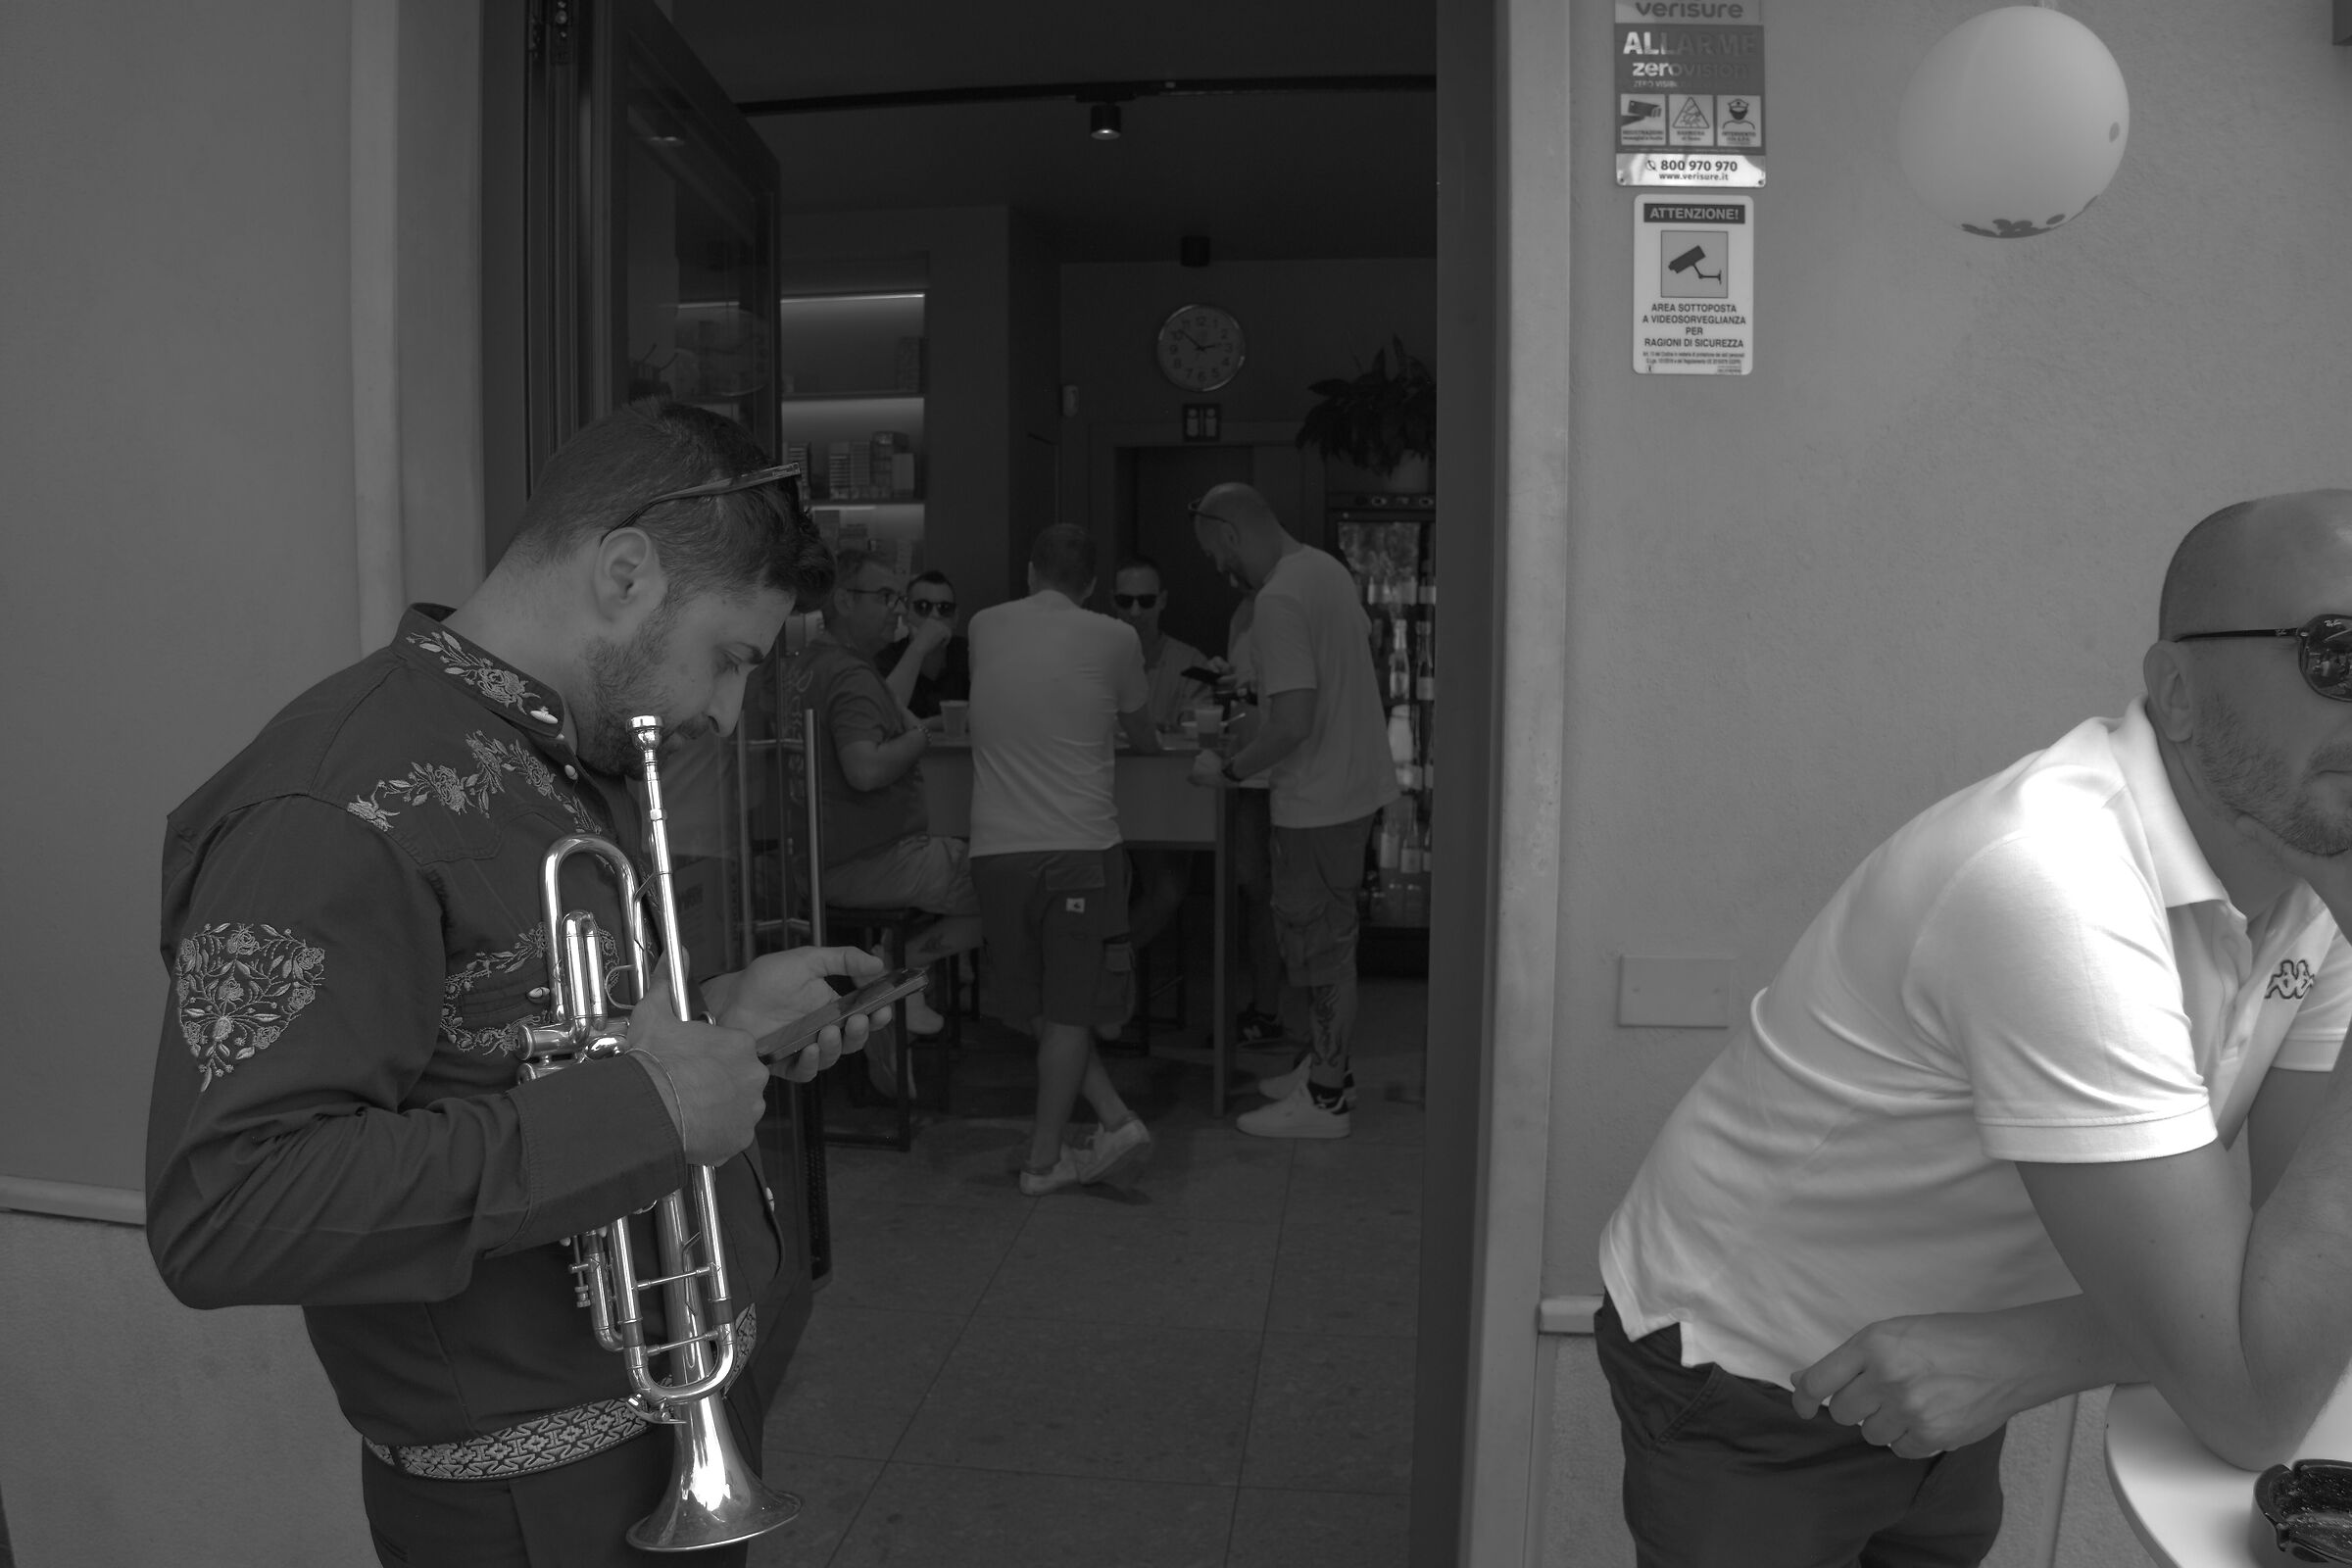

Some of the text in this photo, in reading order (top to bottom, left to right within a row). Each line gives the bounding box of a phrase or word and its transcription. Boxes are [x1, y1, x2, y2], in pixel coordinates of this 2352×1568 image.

[1635, 2, 1743, 18] verisure
[1660, 160, 1739, 172] 800 970 970
[1659, 172, 1729, 181] www.verisure.it
[1649, 207, 1740, 220] ATTENZIONE!
[1651, 303, 1737, 314] AREA SOTTOPOSTA
[1642, 315, 1746, 324] A VIDEOSORVEGLIANZA
[1685, 326, 1703, 335] PER
[1644, 338, 1744, 348] RAGIONI DI SICUREZZA
